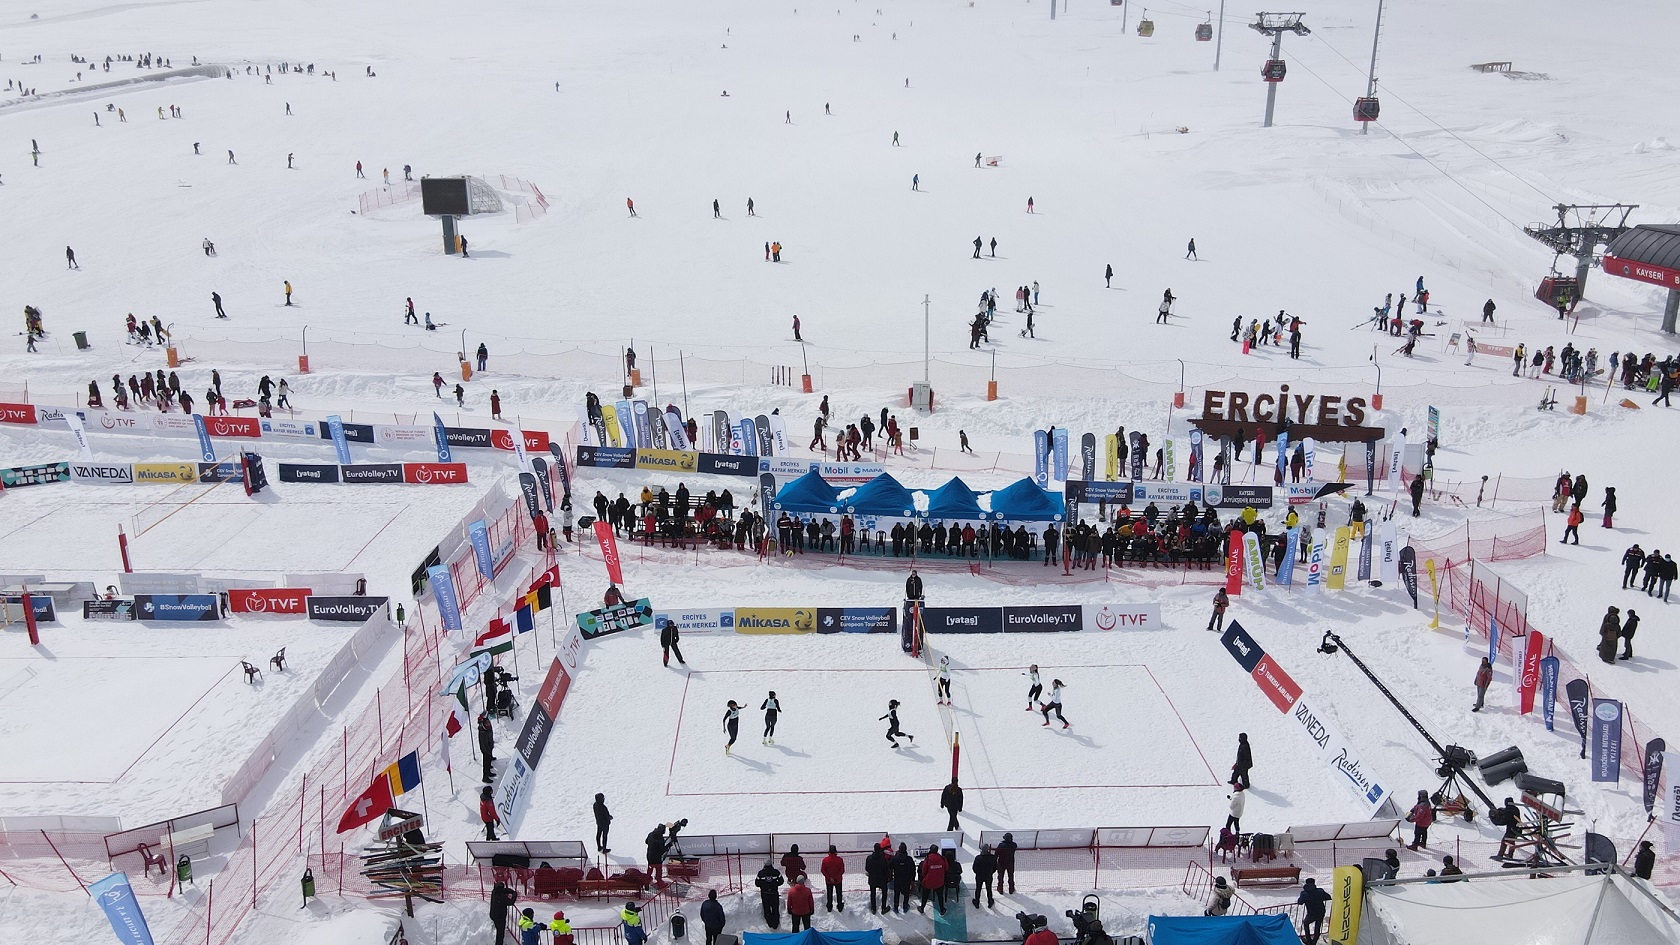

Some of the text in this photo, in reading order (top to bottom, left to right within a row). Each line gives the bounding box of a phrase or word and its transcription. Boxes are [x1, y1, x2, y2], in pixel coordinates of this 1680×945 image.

[1202, 384, 1367, 427] ERCİYES
[7, 410, 27, 418] TVF
[116, 418, 136, 428] TVF
[230, 424, 250, 434] TVF
[447, 434, 486, 442] roVolley.TV
[525, 439, 538, 448] VF
[73, 466, 130, 478] VANEDA
[346, 470, 398, 479] EuroVolley.TV
[434, 470, 456, 480] TVF
[268, 598, 299, 610] TVF
[692, 620, 718, 629] MERKEZİ
[1008, 614, 1076, 626] EuroVolley.TV
[1119, 614, 1148, 626] TVF
[570, 635, 582, 654] TVF
[1265, 670, 1294, 704] TURKISH AIRLINES
[1294, 701, 1330, 750] VANEDA
[523, 711, 546, 760] EuroVolley.TV
[1331, 747, 1370, 793] Radisson
[498, 772, 520, 826] Radisson
[380, 818, 422, 840] ERCİYES
